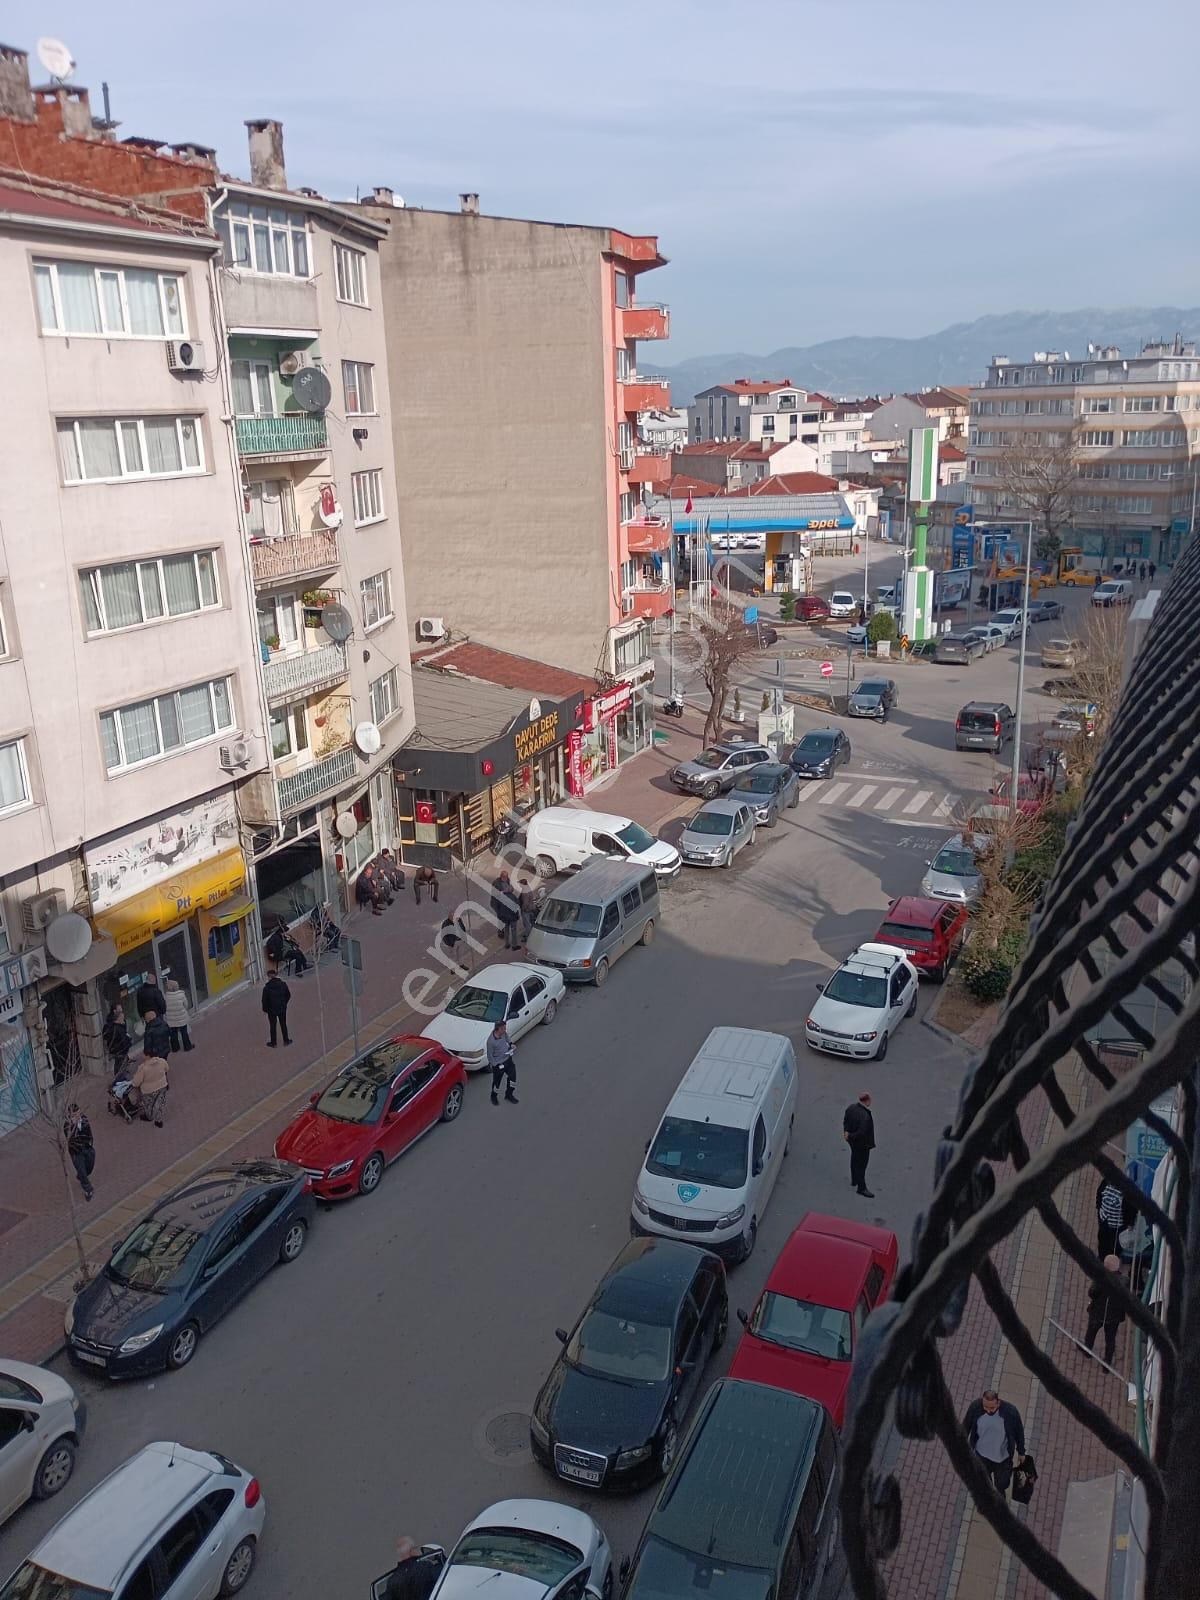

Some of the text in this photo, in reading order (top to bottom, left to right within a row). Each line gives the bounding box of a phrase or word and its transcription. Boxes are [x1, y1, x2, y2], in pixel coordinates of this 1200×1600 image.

[807, 518, 840, 529] opet
[515, 711, 559, 748] DAVUT DEDE
[177, 895, 192, 913] Ptt
